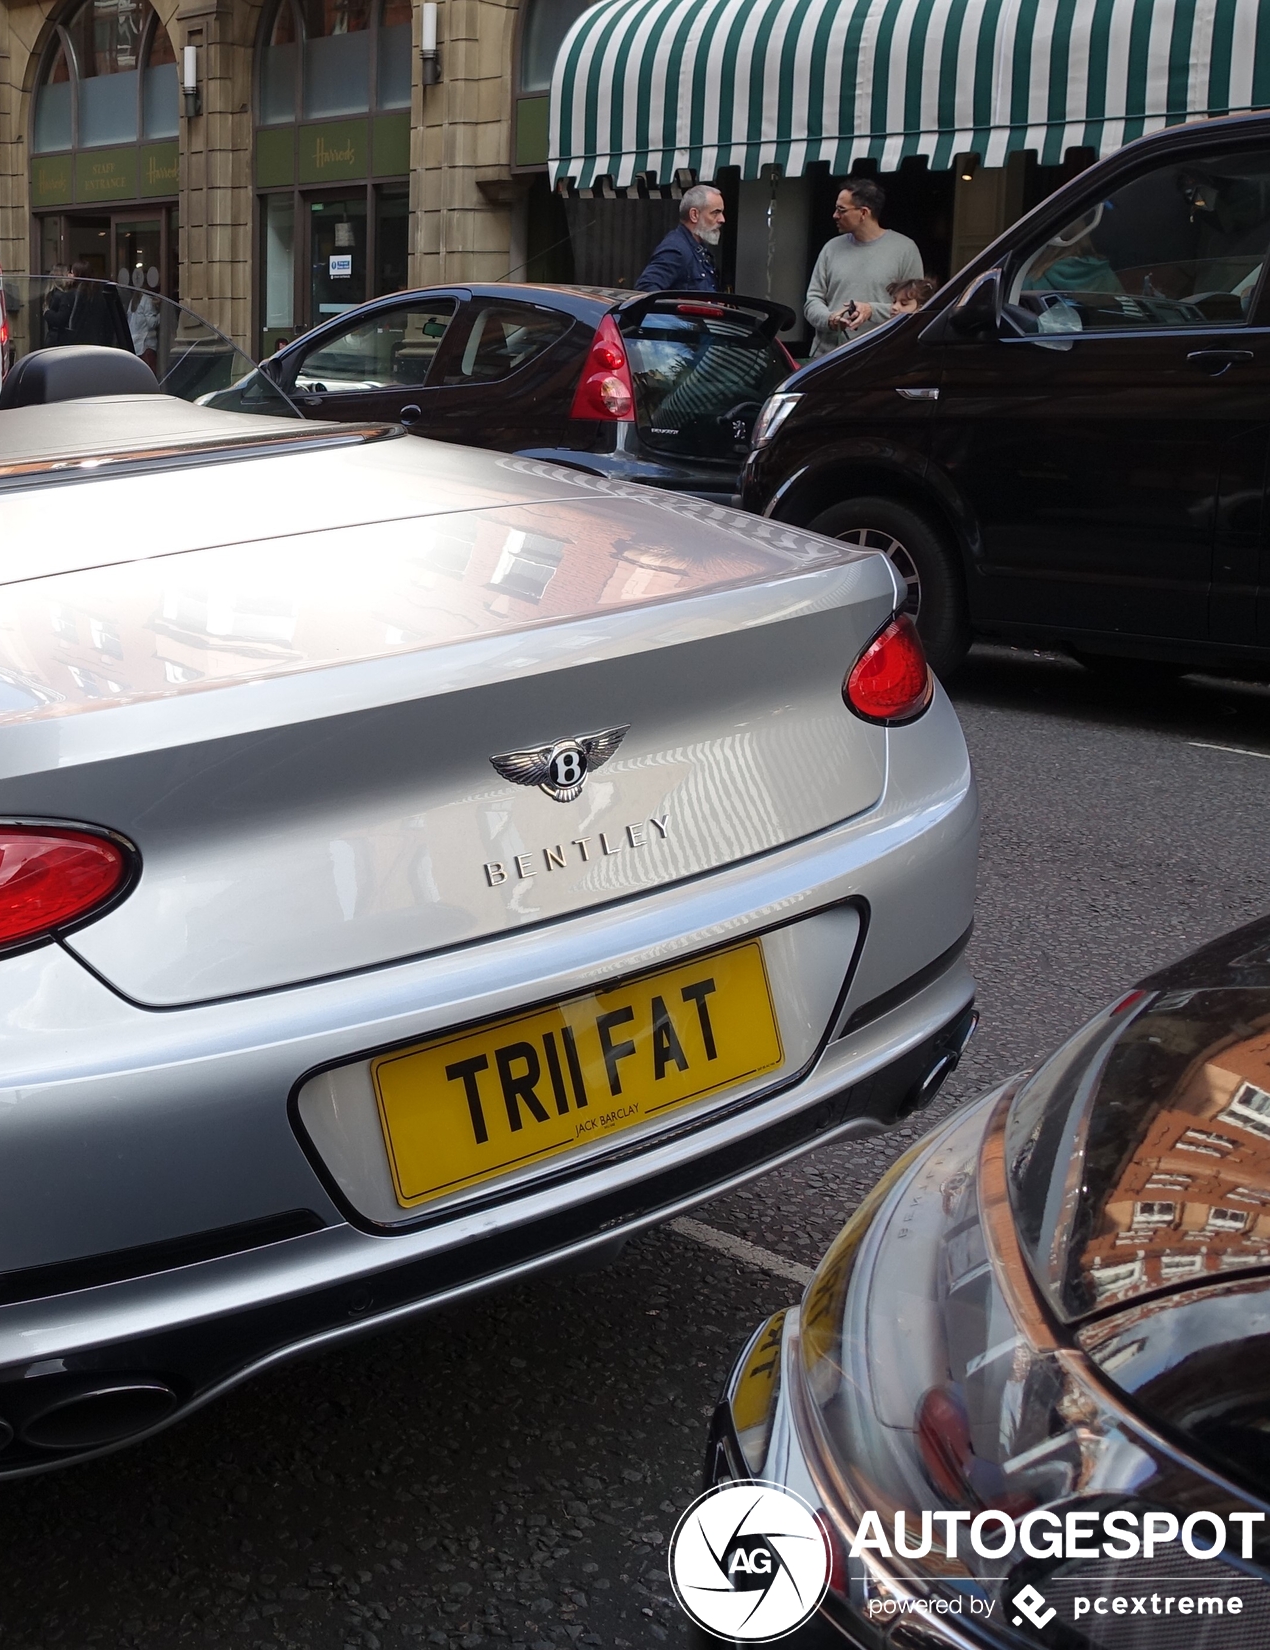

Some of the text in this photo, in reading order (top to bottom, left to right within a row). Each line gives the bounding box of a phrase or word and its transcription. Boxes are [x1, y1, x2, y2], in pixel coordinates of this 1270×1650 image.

[92, 163, 116, 174] STAFF
[312, 137, 355, 168] Harrods
[85, 177, 126, 190] ENTRANCE
[483, 814, 670, 887] BENTLEY
[596, 978, 718, 1096] FAT
[575, 1102, 639, 1138] JACK BARCLAY
